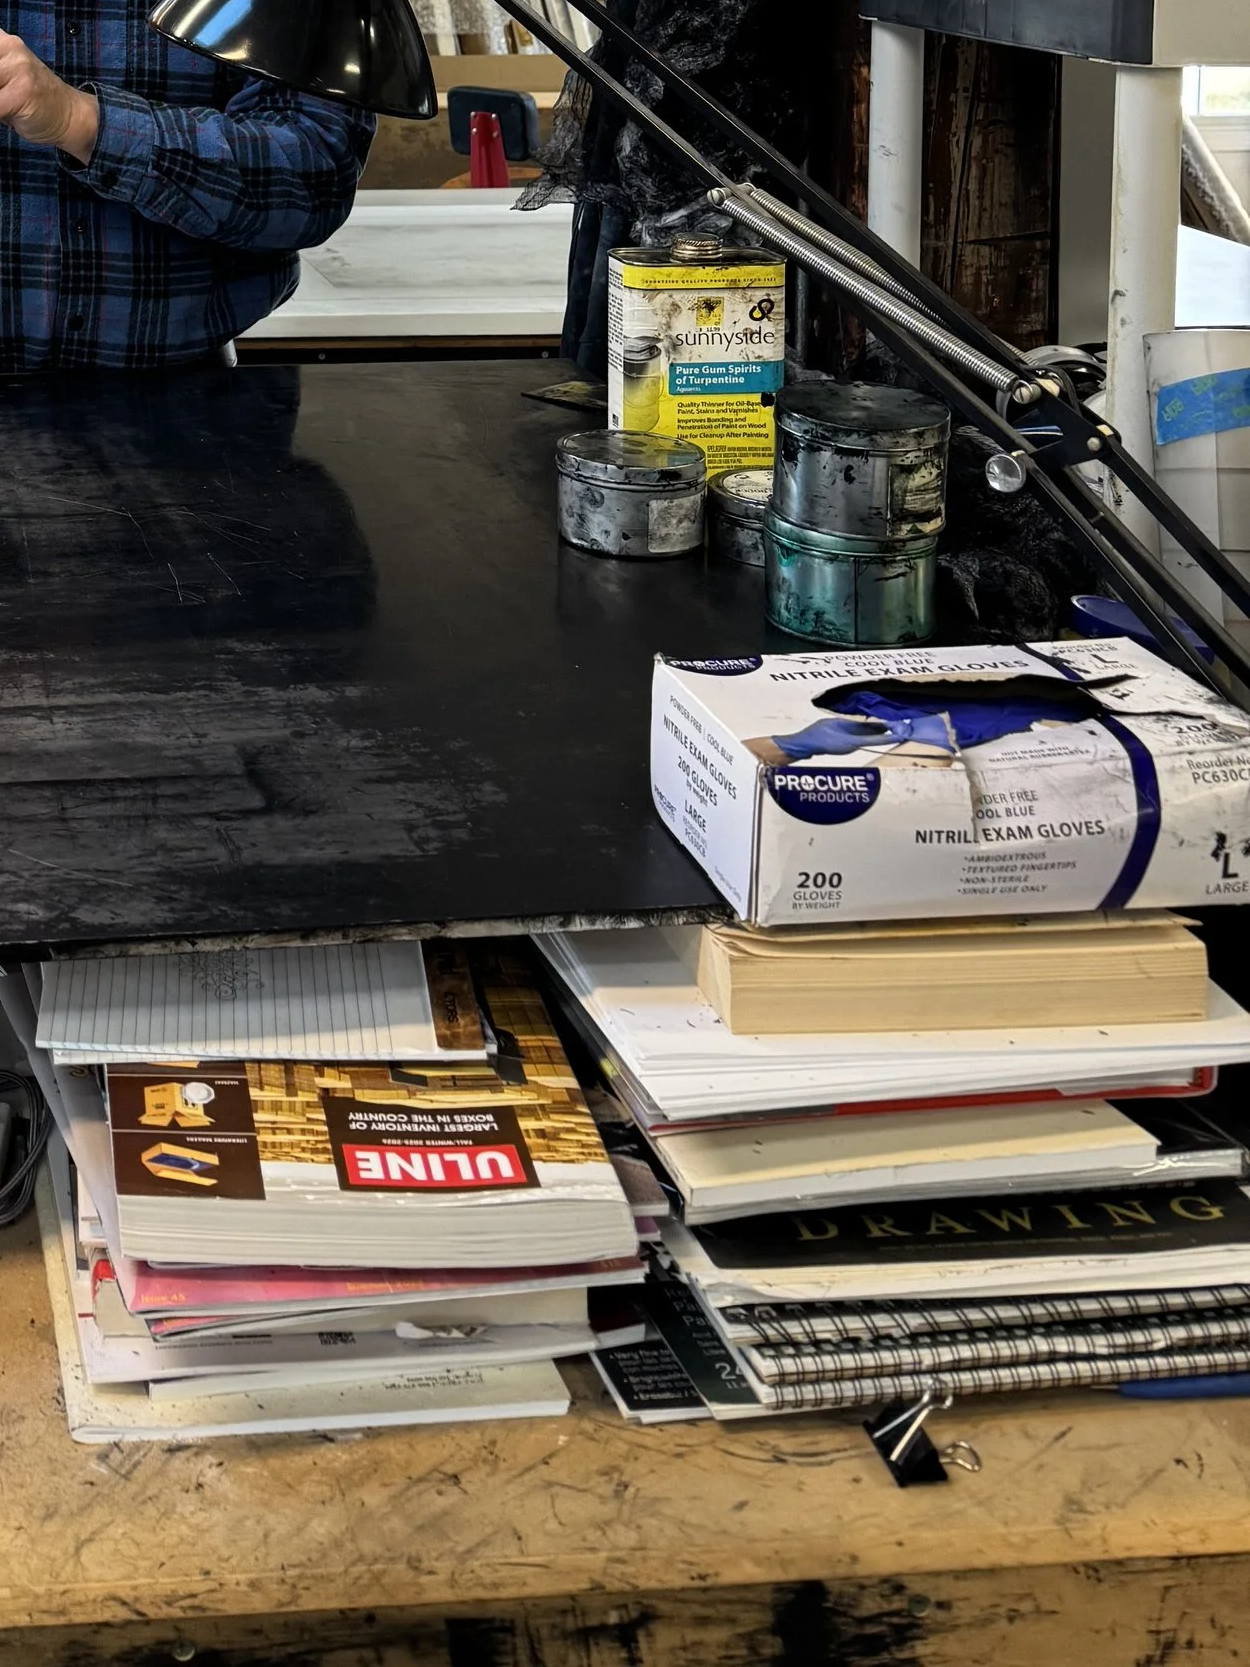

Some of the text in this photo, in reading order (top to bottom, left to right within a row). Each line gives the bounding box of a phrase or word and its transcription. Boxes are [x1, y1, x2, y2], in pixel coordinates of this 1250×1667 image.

[675, 326, 775, 352] sunnyside
[675, 364, 761, 375] Pure Gum Spirits
[675, 375, 745, 386] of Turpentine
[742, 431, 769, 439] Painting
[898, 651, 937, 659] FREE
[845, 658, 936, 668] COOL BLUE
[769, 660, 1030, 682] NITRILE EXAM GLOVES
[670, 695, 734, 766] POWDER FREE COOL BLUE
[663, 714, 737, 800] NITRILE EXAM GLOVES
[1186, 756, 1233, 770] Reorder
[677, 755, 718, 807] 200 GLOVES
[800, 791, 870, 804] PRODUCTS
[981, 790, 1039, 805] DER FREE
[684, 799, 707, 833] LARGE
[976, 805, 1036, 820] OOL BLUE
[981, 826, 1033, 843] EXAM
[1038, 819, 1106, 840] GLOVES
[967, 852, 1047, 862] AMBIDEXTROUS
[966, 861, 1077, 874] TEXTURED FINGERTIPS
[1222, 852, 1239, 879] L
[797, 871, 843, 889] 200
[963, 875, 1029, 884] NON-STERILE
[961, 884, 1047, 895] SINGLE USE ONLY
[1205, 881, 1249, 895] LARGE
[793, 890, 843, 902] GLOVES
[792, 901, 841, 910] BY WEIGHT
[348, 1111, 494, 1122] BOXES IN THE COUNTRY
[349, 1122, 499, 1132] LARGEST INVENTORY OF
[354, 1150, 516, 1181] ULINE
[793, 1195, 1226, 1241] DRAWING
